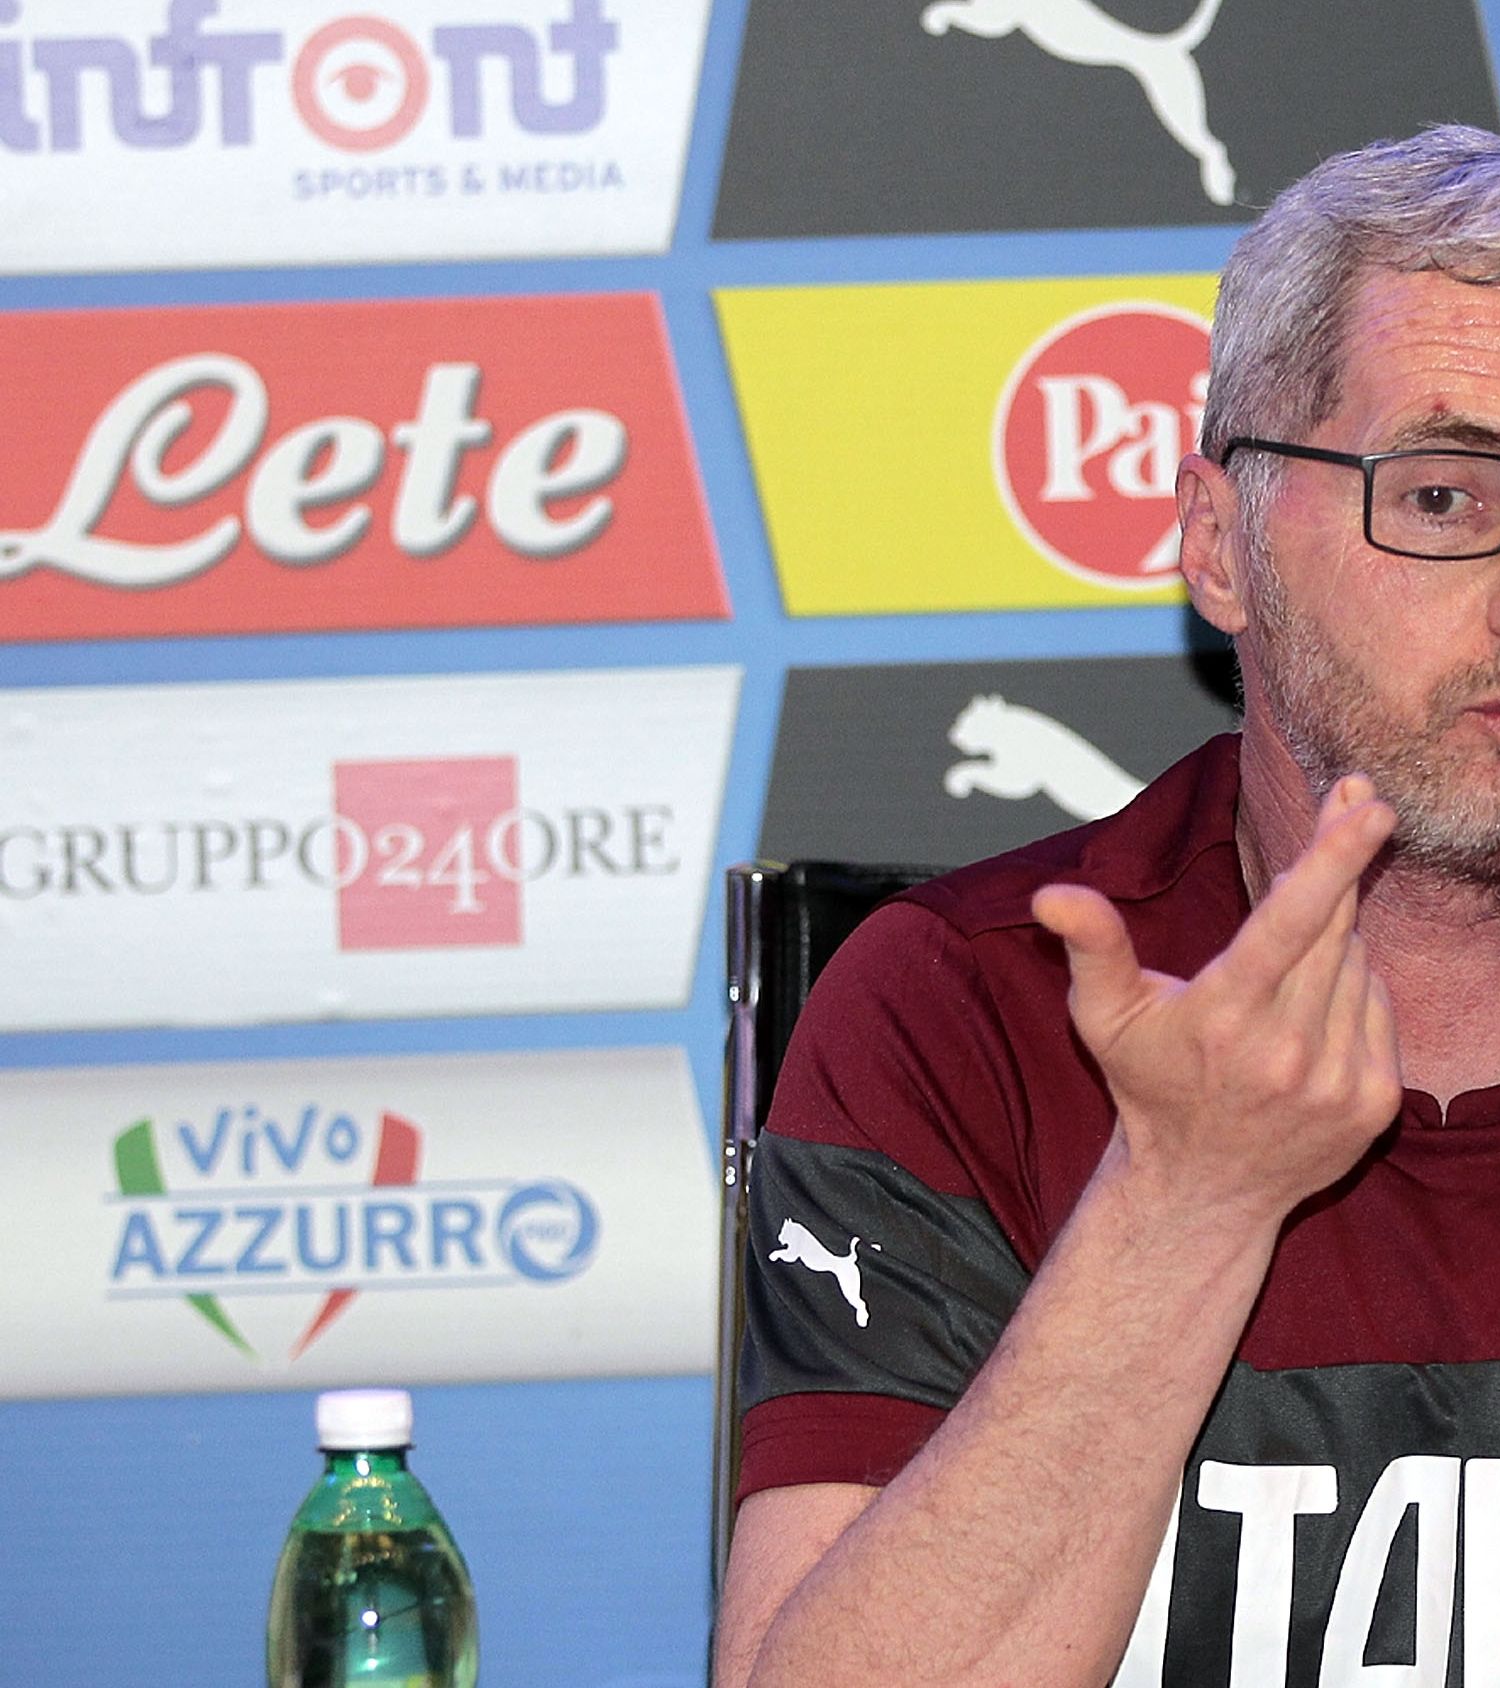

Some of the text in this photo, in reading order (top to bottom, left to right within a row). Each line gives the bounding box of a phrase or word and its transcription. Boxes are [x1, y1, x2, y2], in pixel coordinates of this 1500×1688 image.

[293, 161, 624, 202] SPORTS & MEDIA
[0, 350, 628, 592] Lete
